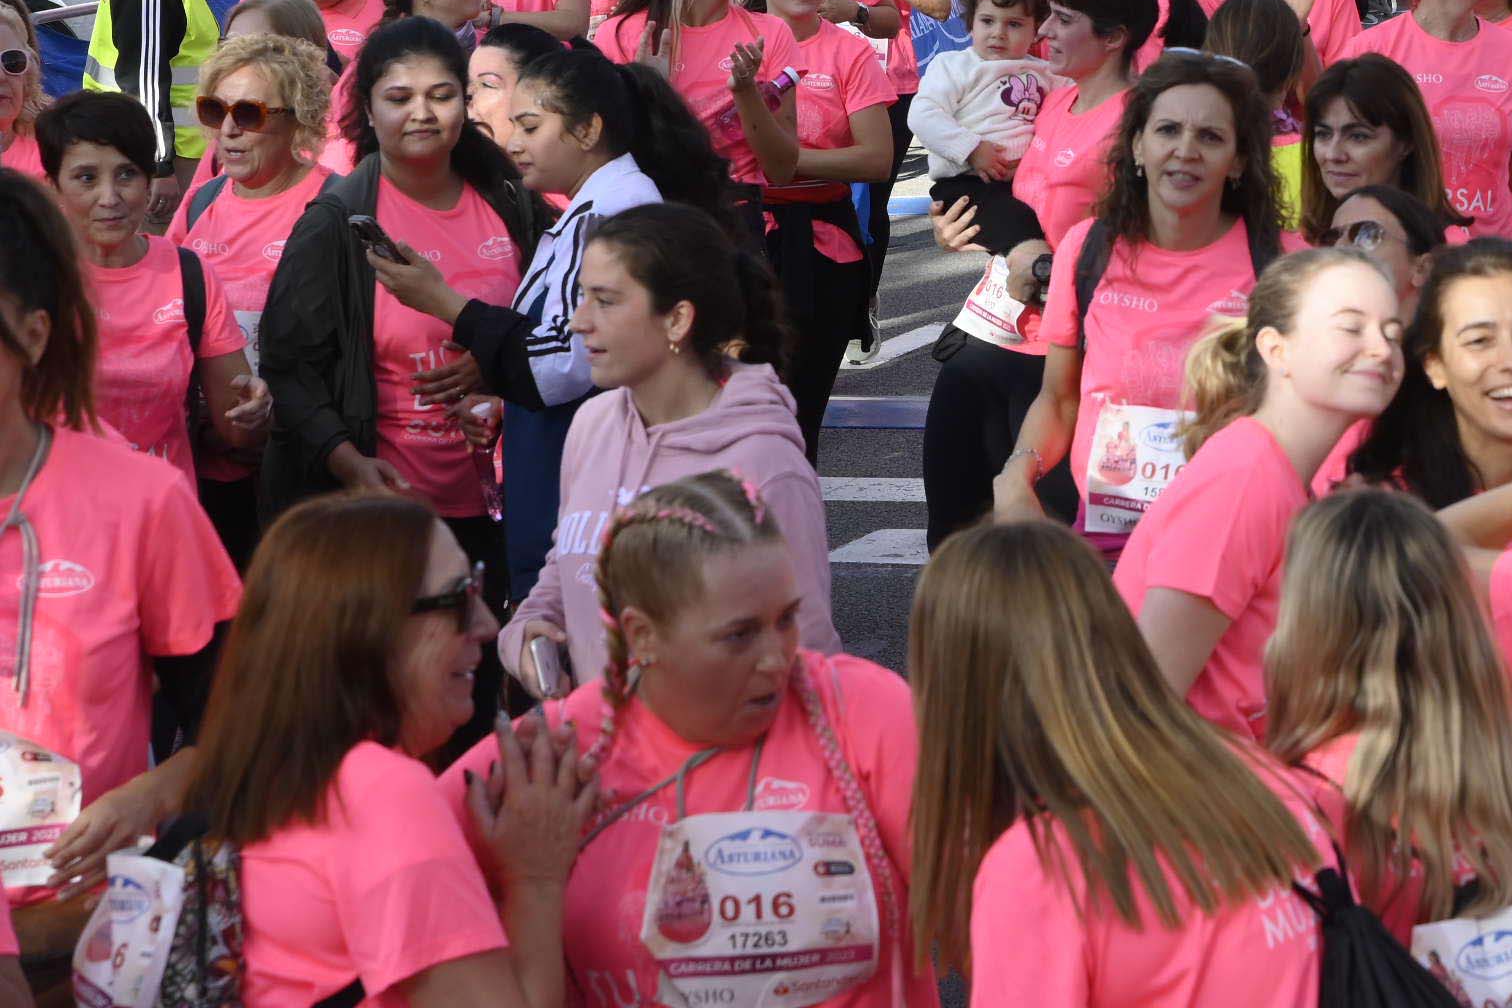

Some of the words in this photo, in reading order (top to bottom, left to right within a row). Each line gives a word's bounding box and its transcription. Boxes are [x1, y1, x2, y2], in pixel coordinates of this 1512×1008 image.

[1416, 72, 1443, 83] SHO
[1444, 186, 1495, 213] RSAL
[1100, 289, 1158, 313] OYSHO
[1143, 485, 1163, 499] 15
[714, 848, 796, 866] ASTURIANA
[719, 892, 796, 924] 016
[728, 929, 789, 951] 17263
[670, 959, 732, 975] CARRERA
[734, 958, 753, 972] DE
[755, 956, 774, 970] LA
[681, 986, 735, 1007] YSHO
